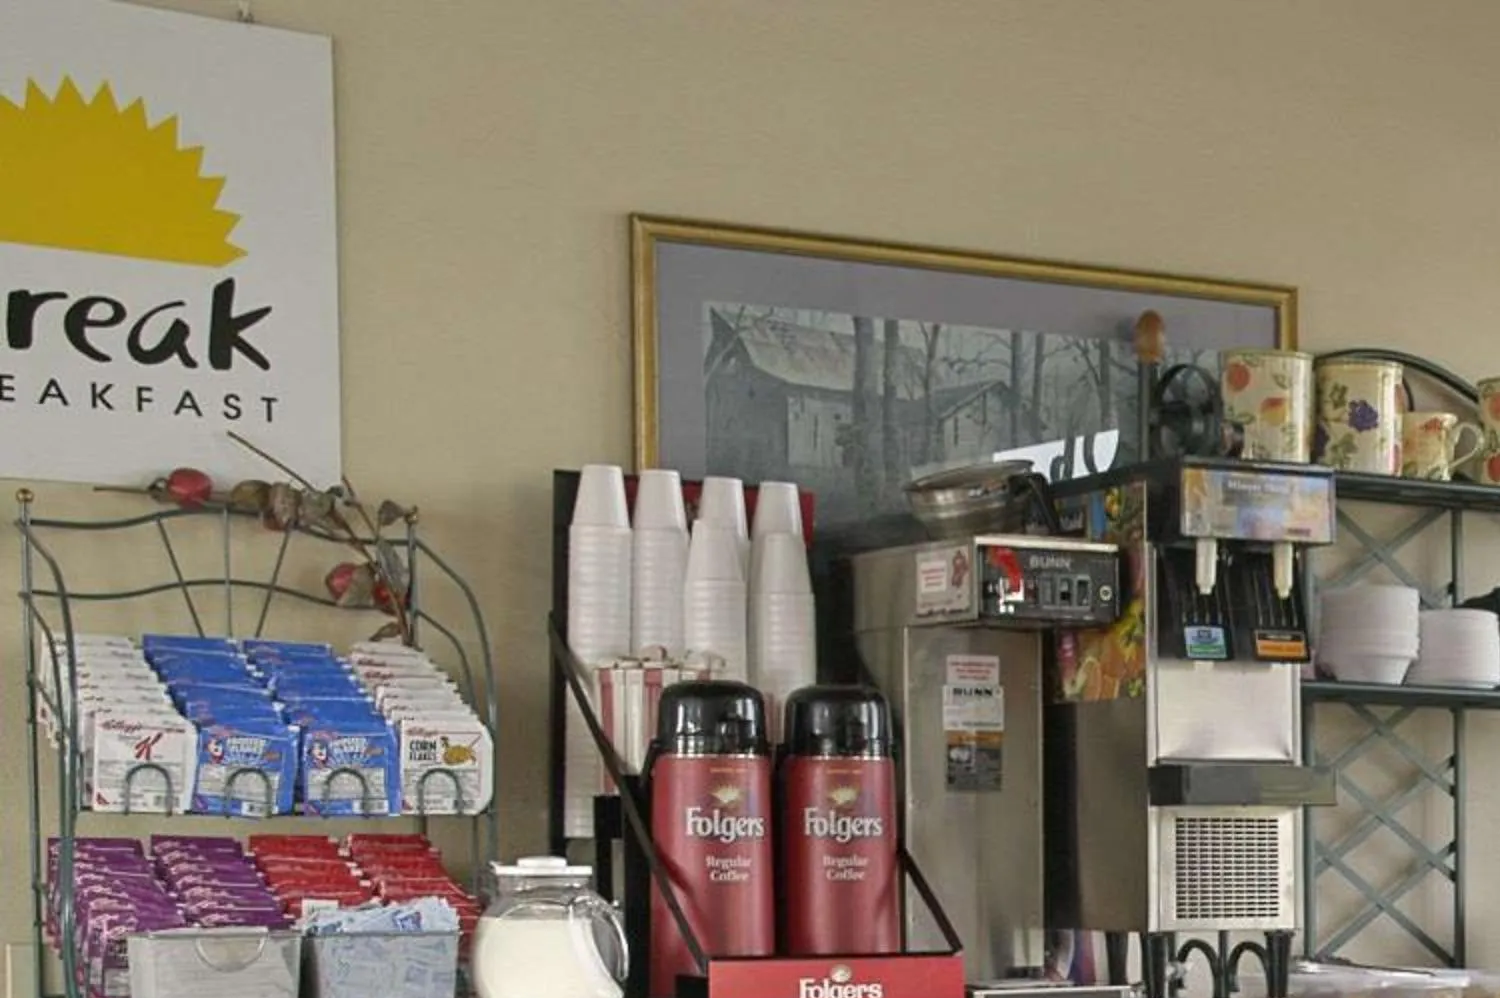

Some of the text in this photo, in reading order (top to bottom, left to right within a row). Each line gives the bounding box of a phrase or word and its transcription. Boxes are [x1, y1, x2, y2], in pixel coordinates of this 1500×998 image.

[6, 277, 273, 371] reak
[0, 374, 279, 423] EAKFAST
[1029, 554, 1072, 570] BUNN
[952, 686, 993, 697] BUNN
[409, 739, 437, 752] CORN
[684, 806, 765, 843] Folgers
[804, 806, 883, 843] Folgers
[705, 855, 752, 869] Regular
[822, 855, 869, 868] Regular
[709, 868, 750, 882] Coffee
[825, 868, 866, 882] Coffee
